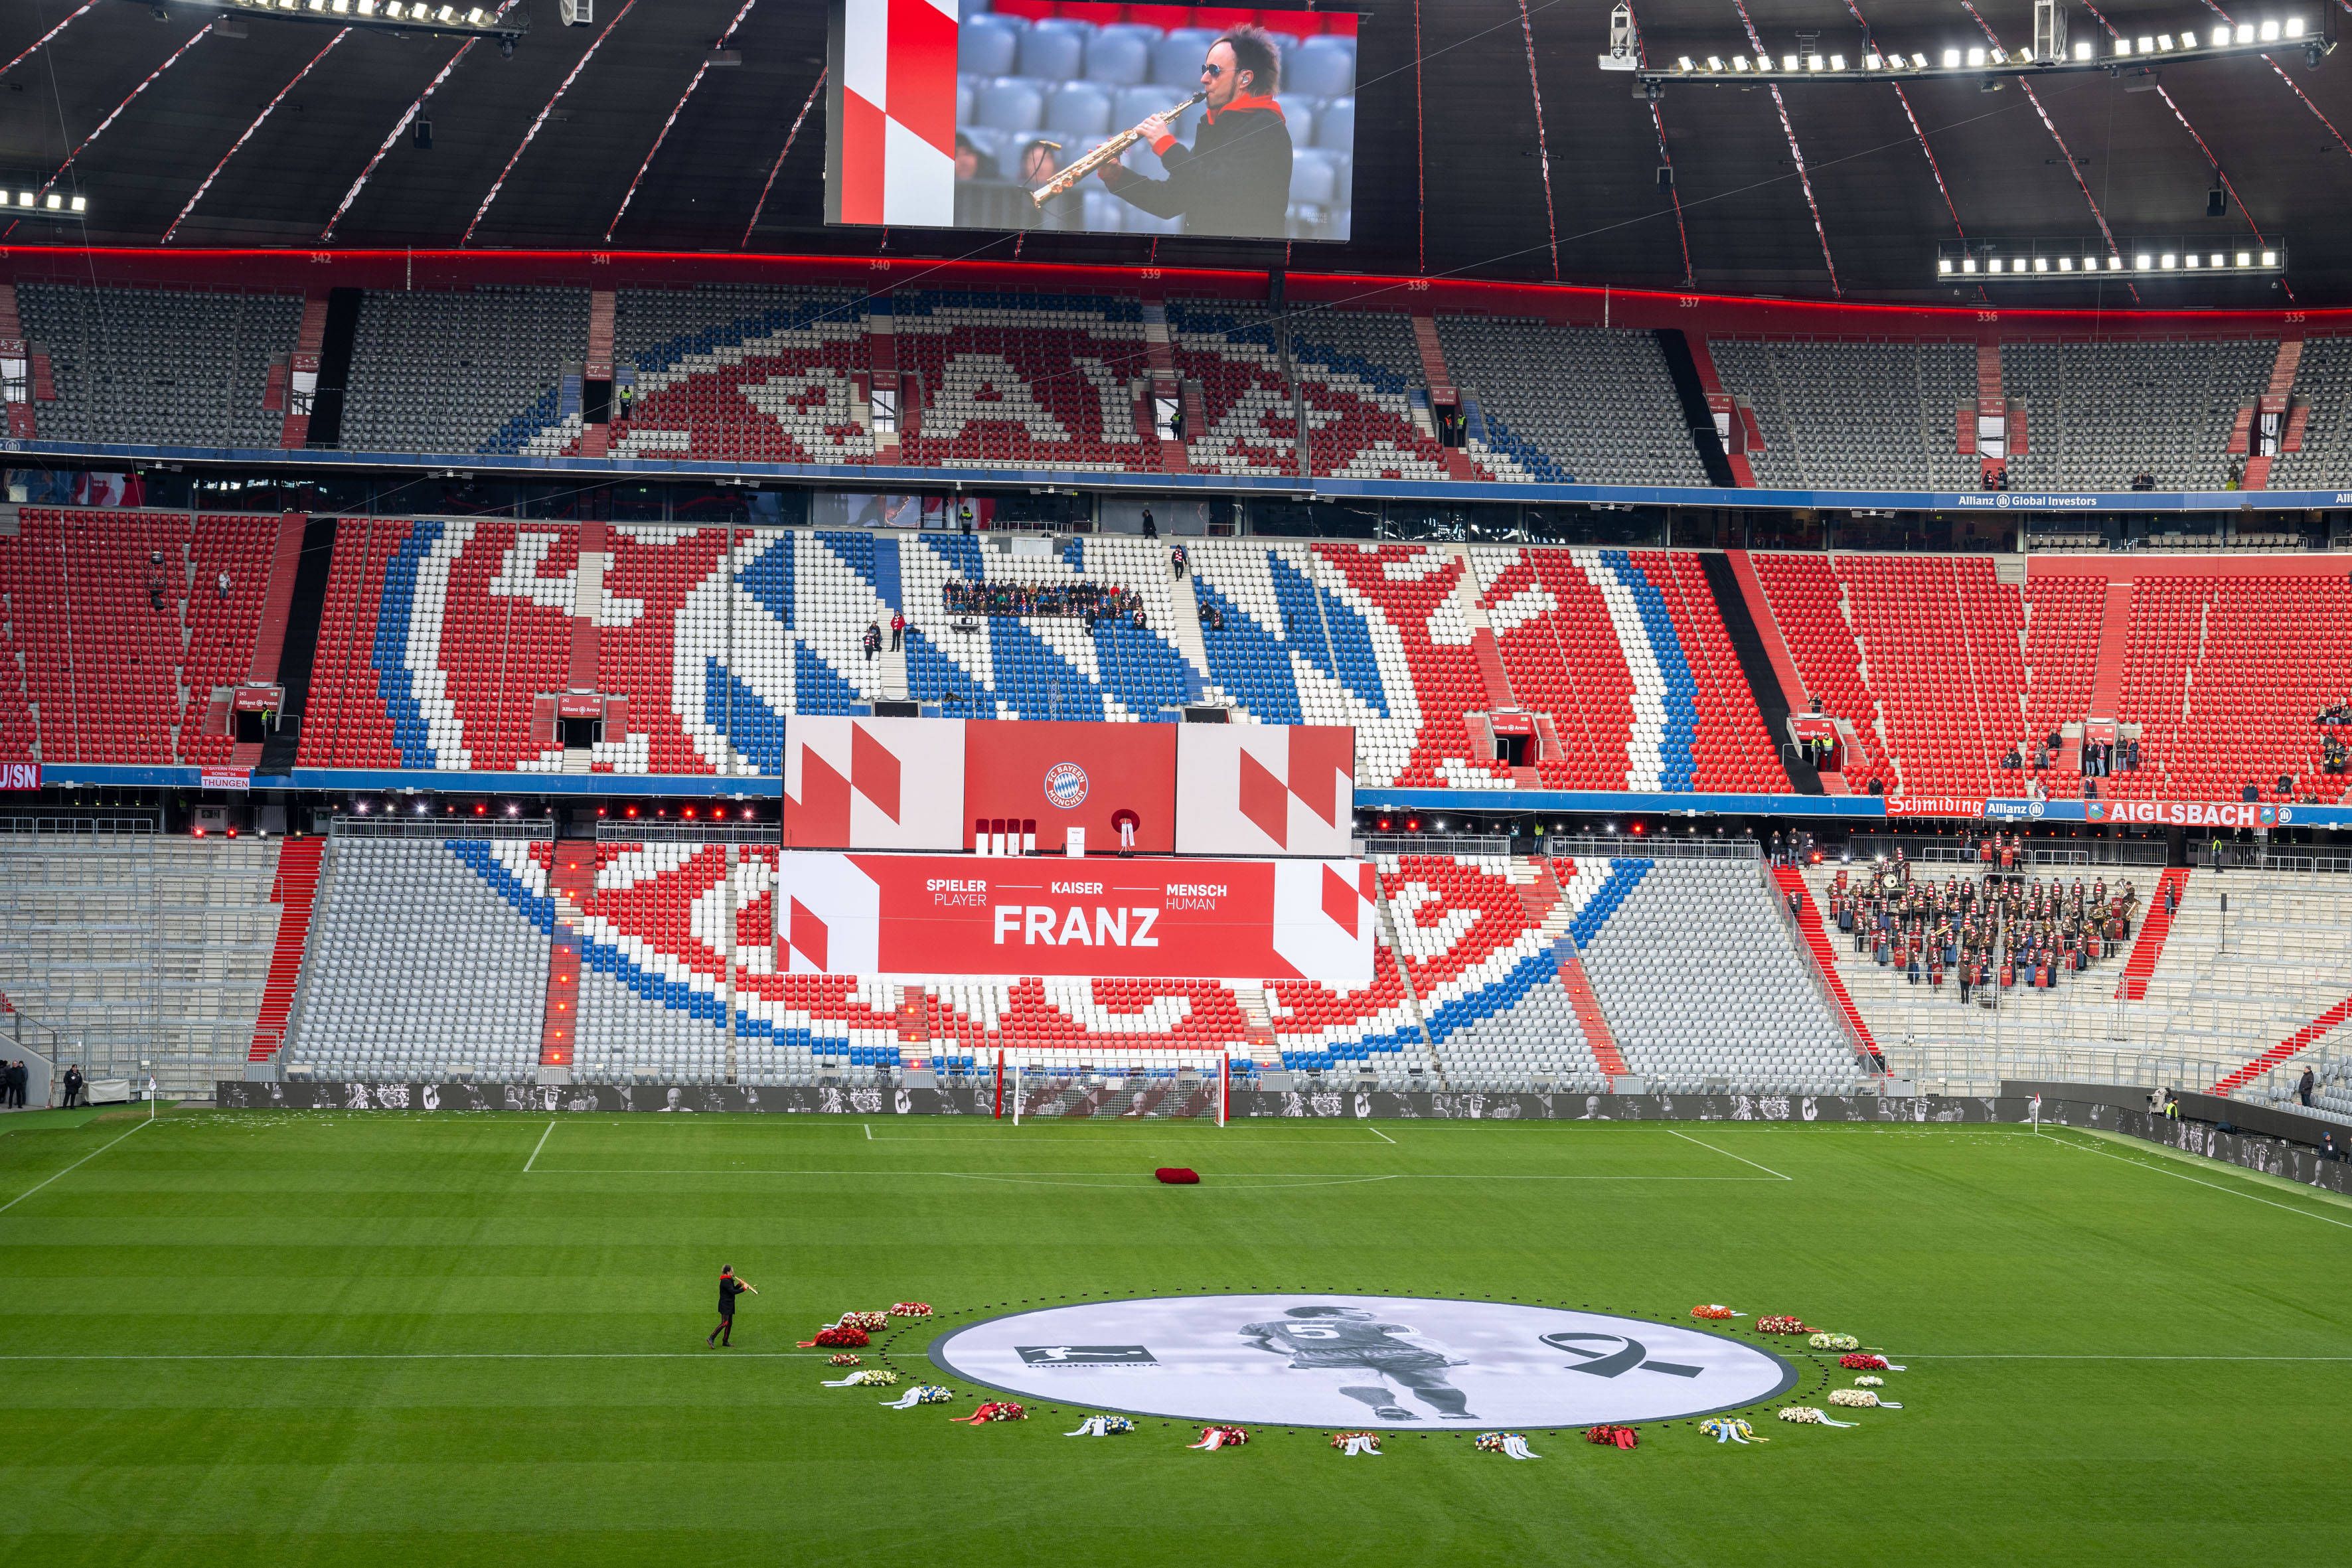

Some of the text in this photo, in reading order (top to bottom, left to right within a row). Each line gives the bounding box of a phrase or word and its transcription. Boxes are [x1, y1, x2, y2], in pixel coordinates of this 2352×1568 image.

[311, 252, 331, 264] 342
[591, 254, 610, 265] 341
[870, 260, 890, 270] 340
[1141, 269, 1160, 279] 339
[1408, 280, 1428, 291] 338
[1680, 297, 1700, 307] 337
[1977, 311, 1998, 322] 336
[2283, 312, 2304, 323] 335
[1959, 496, 2097, 506] Allianz Global Investors
[1048, 771, 1057, 782] FC
[1057, 765, 1085, 783] BAYERN
[202, 778, 248, 787] THÜNGEN
[1987, 801, 2027, 814] Allianz
[2110, 803, 2255, 826] AIGLSBACH
[927, 879, 1227, 897] SPIELER KAISER MENSCH
[935, 894, 1215, 910] PLAYER HUMAN
[994, 905, 1159, 947] FRANZ
[1286, 1324, 1341, 1339] 5
